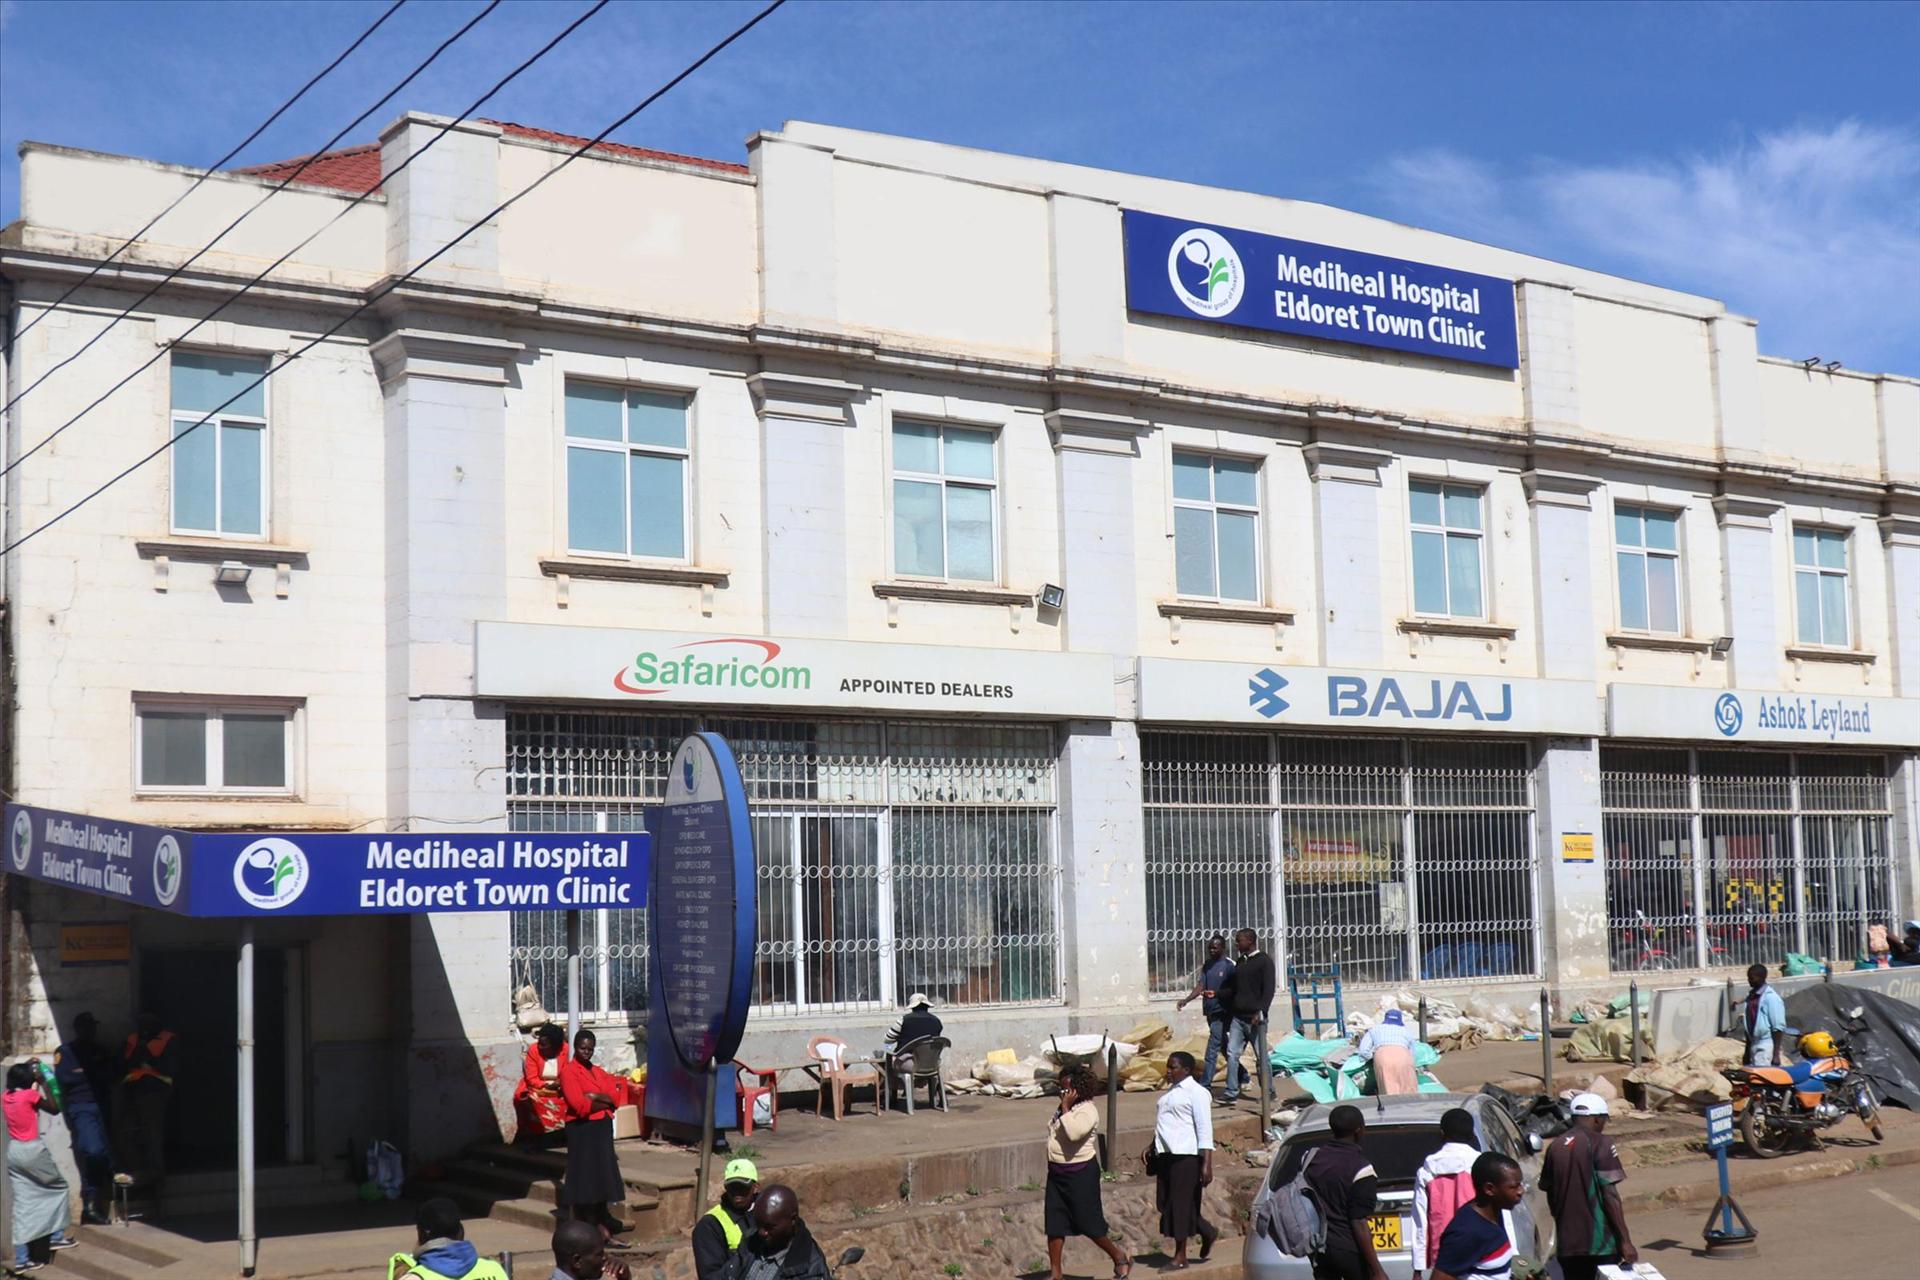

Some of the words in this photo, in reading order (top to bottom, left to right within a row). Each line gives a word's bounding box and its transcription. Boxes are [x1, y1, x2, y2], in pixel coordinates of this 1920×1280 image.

[1277, 254, 1386, 299] Mediheal
[1390, 273, 1480, 315] Hospital
[1274, 289, 1361, 330] Eldoret
[1362, 304, 1424, 340] Town
[1427, 315, 1486, 350] Clinic
[634, 651, 812, 689] Safaricom
[839, 678, 936, 695] APPOINTED
[941, 682, 1014, 699] DEALERS
[1328, 676, 1513, 721] BAJAJ
[1758, 696, 1807, 730] Ashok
[1811, 699, 1872, 740] Leyland
[45, 818, 89, 850] Mediheal
[90, 825, 133, 862] Hospital
[366, 841, 506, 869] Mediheal
[513, 841, 628, 875] Hospital
[42, 852, 76, 883] Eldoret
[76, 858, 102, 889] Town
[104, 864, 133, 896] Clinic
[360, 878, 468, 908] Eldoret
[473, 878, 549, 906] Town
[556, 876, 631, 905] Clinic
